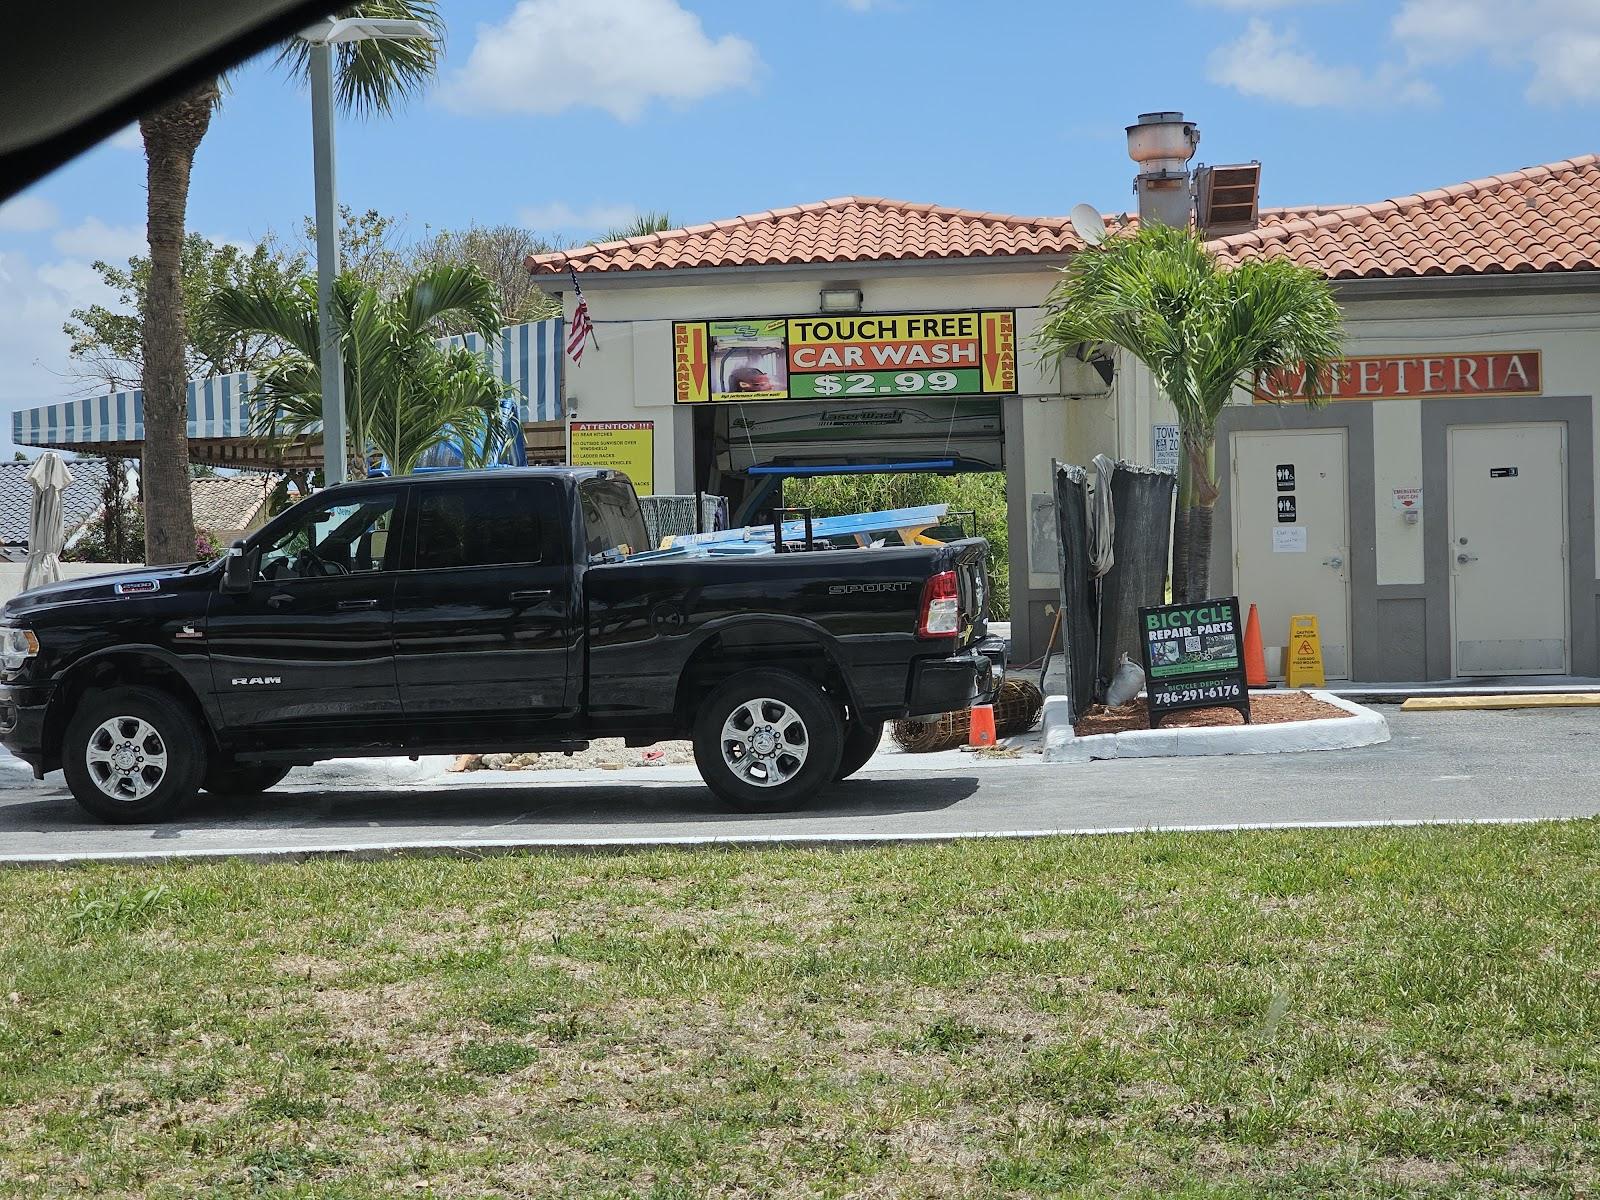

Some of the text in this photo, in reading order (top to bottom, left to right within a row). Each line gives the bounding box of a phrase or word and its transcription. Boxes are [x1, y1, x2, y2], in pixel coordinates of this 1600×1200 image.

[794, 320, 897, 342] TOUCH
[907, 317, 973, 338] FREE
[676, 325, 690, 400] ENTRANCE
[793, 342, 976, 368] CAR WASH
[1000, 314, 1014, 390] ENTRANCE
[813, 371, 958, 396] $2.99
[828, 581, 912, 595] SPORT
[1146, 605, 1232, 630] BICYCLE
[1148, 626, 1192, 641] REPAIR
[1197, 621, 1234, 635] PARTS
[231, 676, 281, 685] RAM
[1200, 680, 1224, 688] DEPOT
[1155, 684, 1240, 705] 786-291-6176
